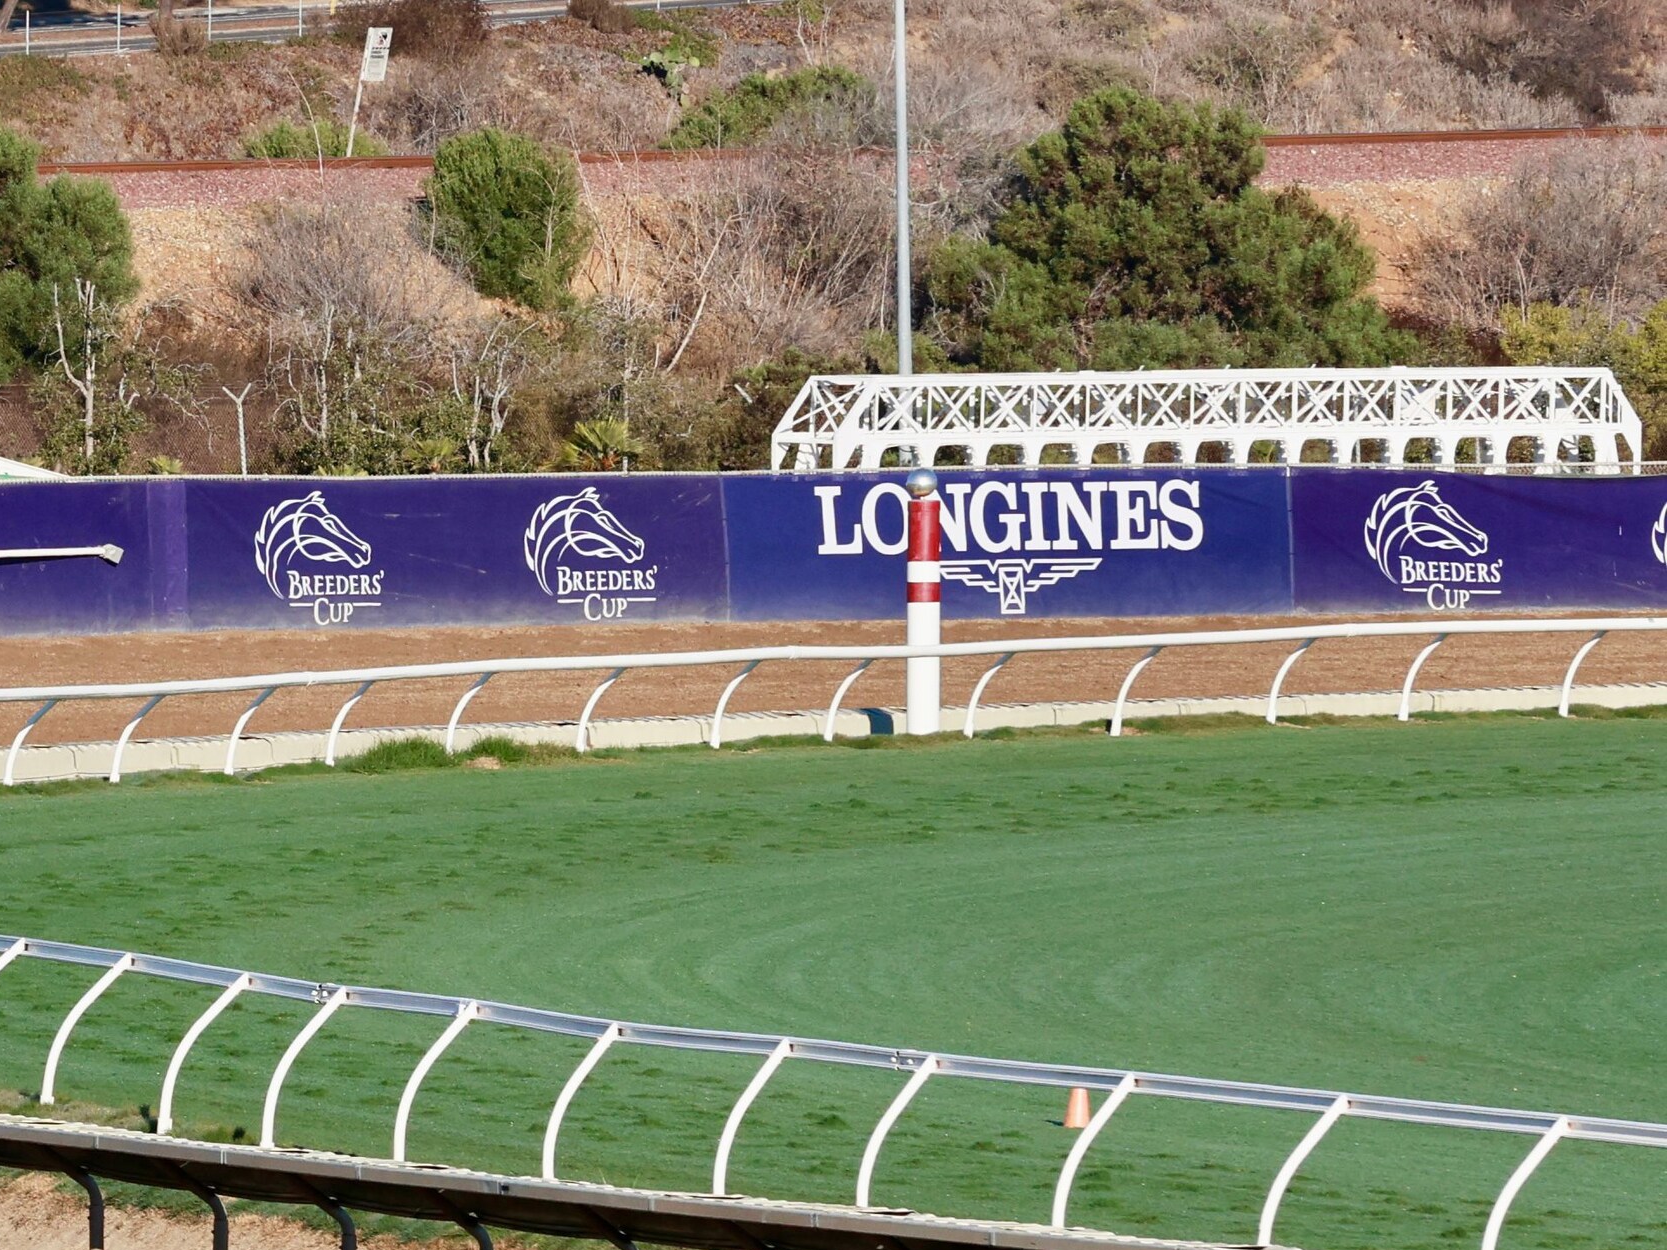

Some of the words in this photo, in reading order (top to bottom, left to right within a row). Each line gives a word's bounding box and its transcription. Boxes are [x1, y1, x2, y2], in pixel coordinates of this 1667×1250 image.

[813, 479, 1204, 555] LONGINES
[556, 565, 658, 595] BREEDERS'
[1399, 555, 1503, 584] BREEDERS'
[286, 570, 385, 599] BREEDERS'
[1426, 583, 1470, 611] CUP
[313, 597, 354, 625] CUP
[583, 593, 627, 621] CUP
